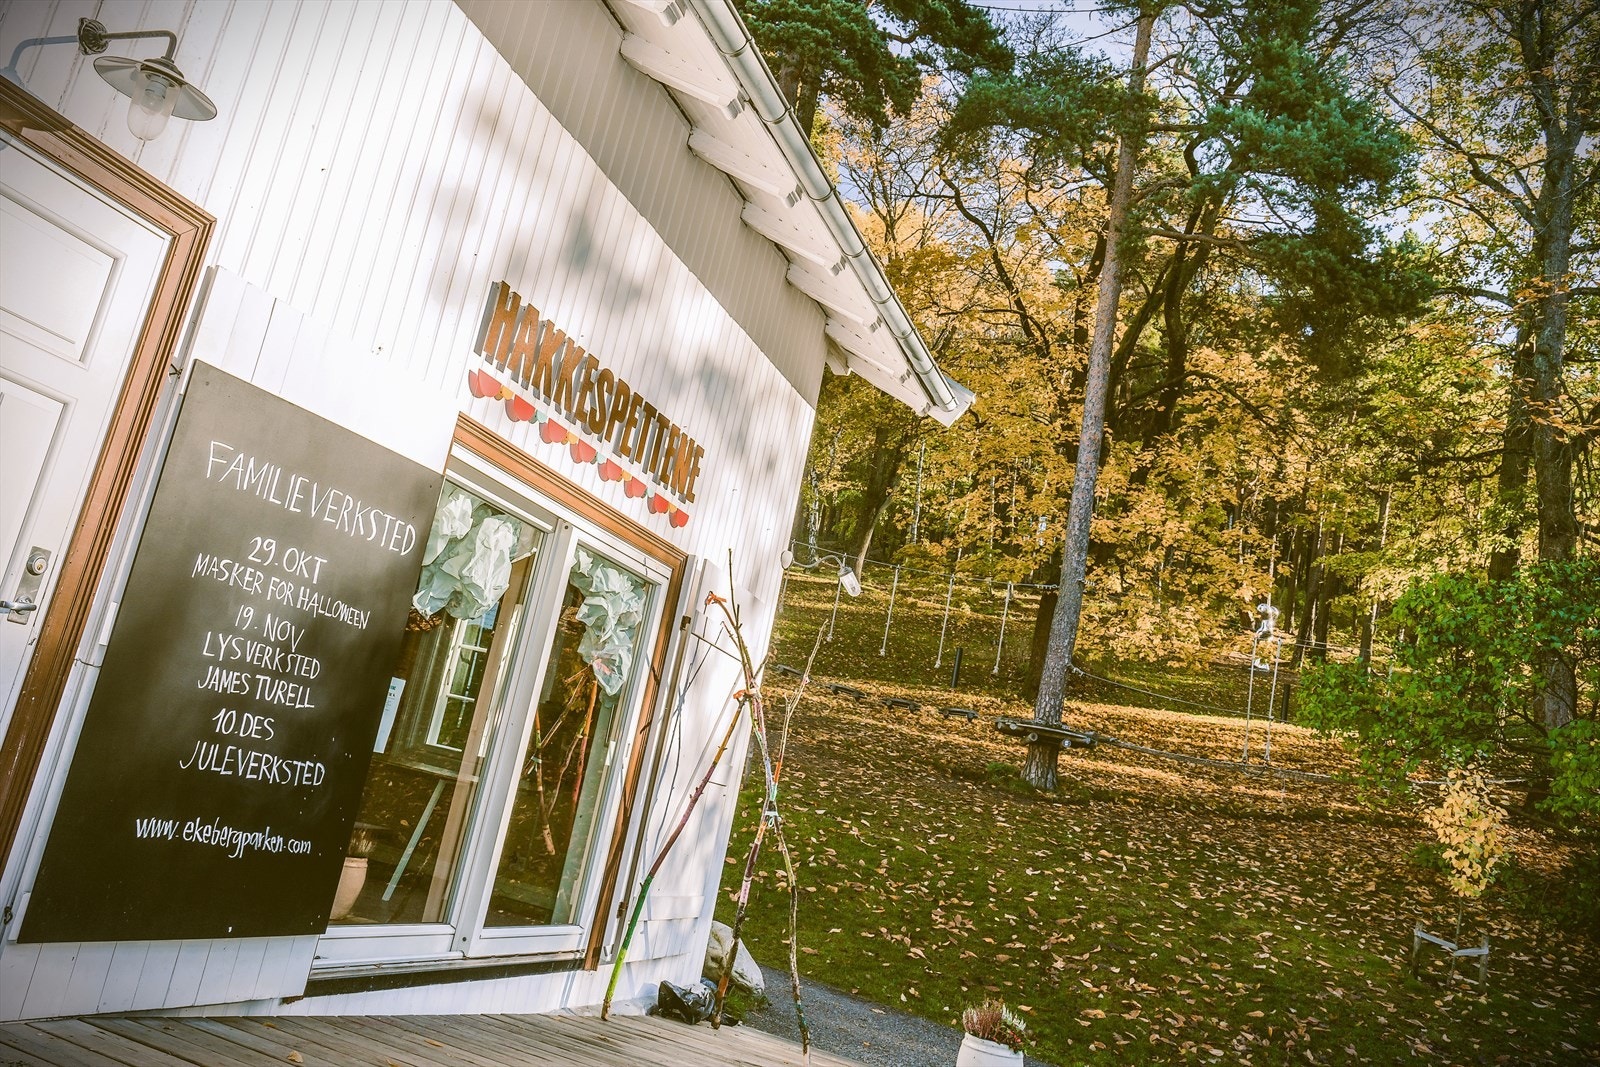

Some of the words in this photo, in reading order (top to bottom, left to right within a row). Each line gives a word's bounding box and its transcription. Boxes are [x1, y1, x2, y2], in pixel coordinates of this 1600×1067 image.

[482, 280, 705, 504] HAKKESPETTENE
[192, 552, 263, 594] MASKER
[296, 586, 370, 630] HALLOWEEN
[235, 603, 258, 631] 19.
[263, 612, 305, 653] NOV
[198, 665, 250, 695] JAMES
[255, 674, 315, 709] TURELL
